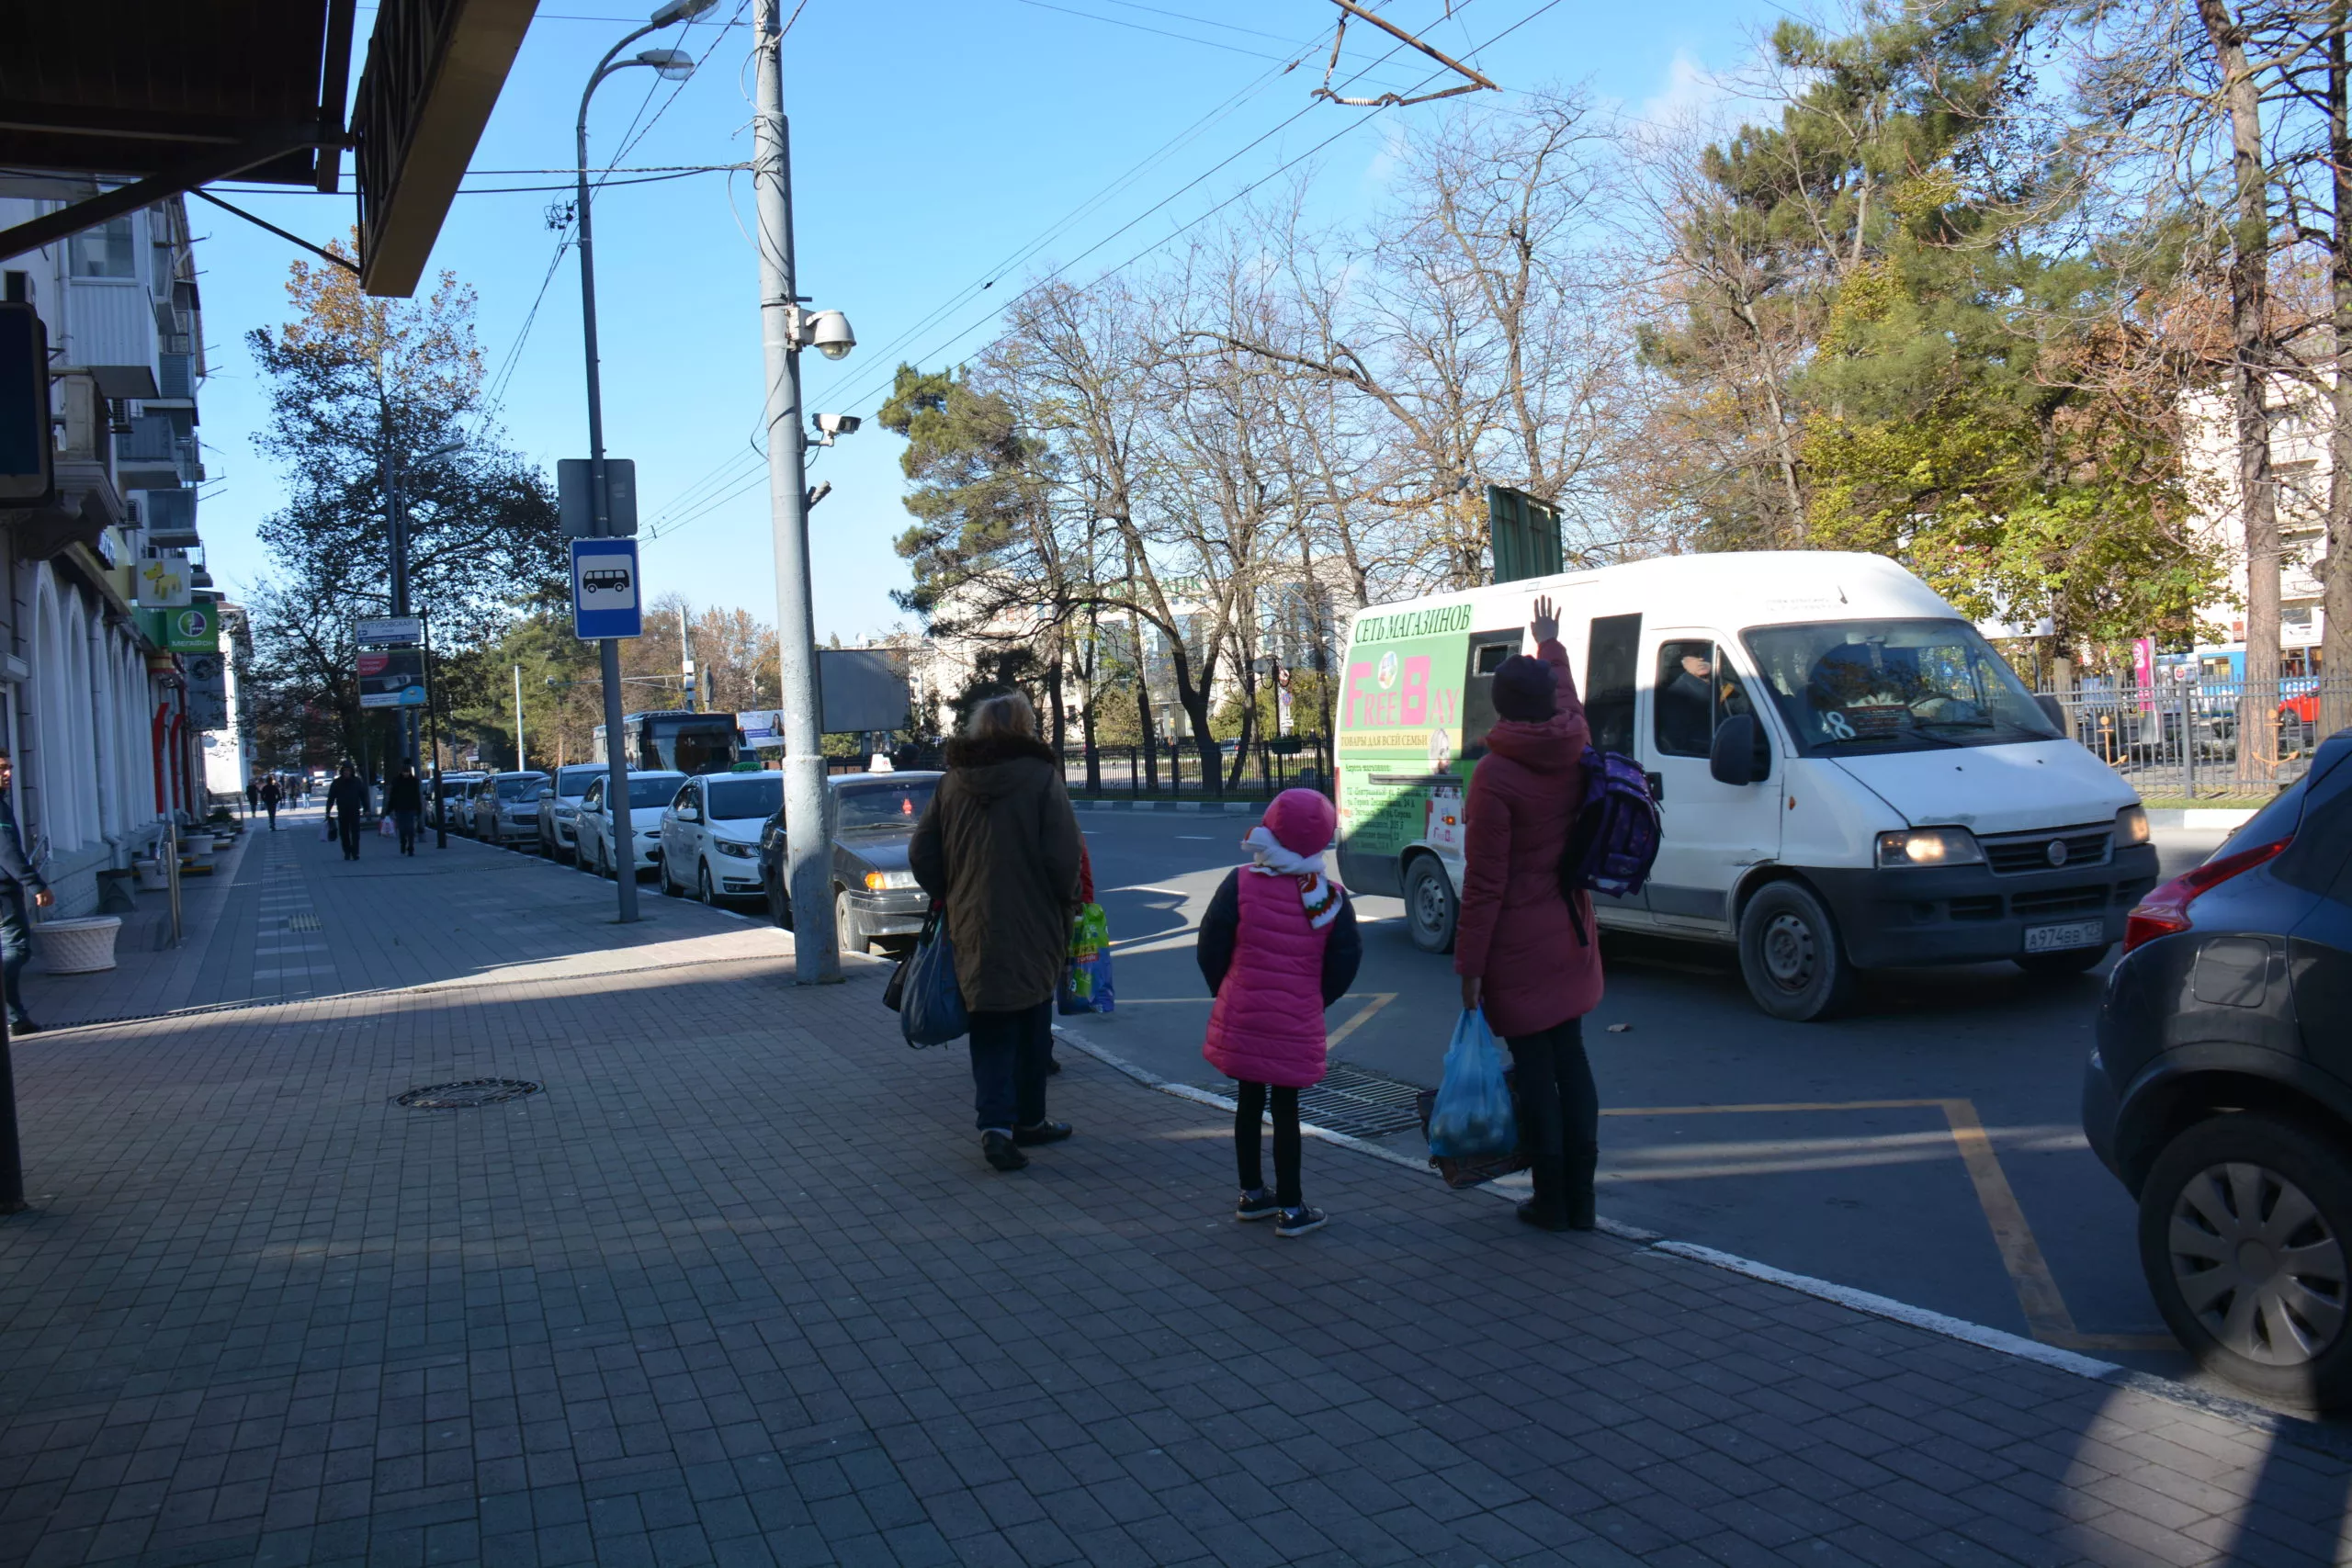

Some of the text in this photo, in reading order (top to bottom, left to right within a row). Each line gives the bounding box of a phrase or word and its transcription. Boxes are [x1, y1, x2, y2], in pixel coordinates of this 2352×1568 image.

[1355, 604, 1471, 644] СЕТЬ МАГАЗИНОВ
[171, 639, 214, 648] МЕГАФОН
[1341, 733, 1428, 747] ТОВАРЫ ДЛЯ ВСЕЙ СЕМЬИ
